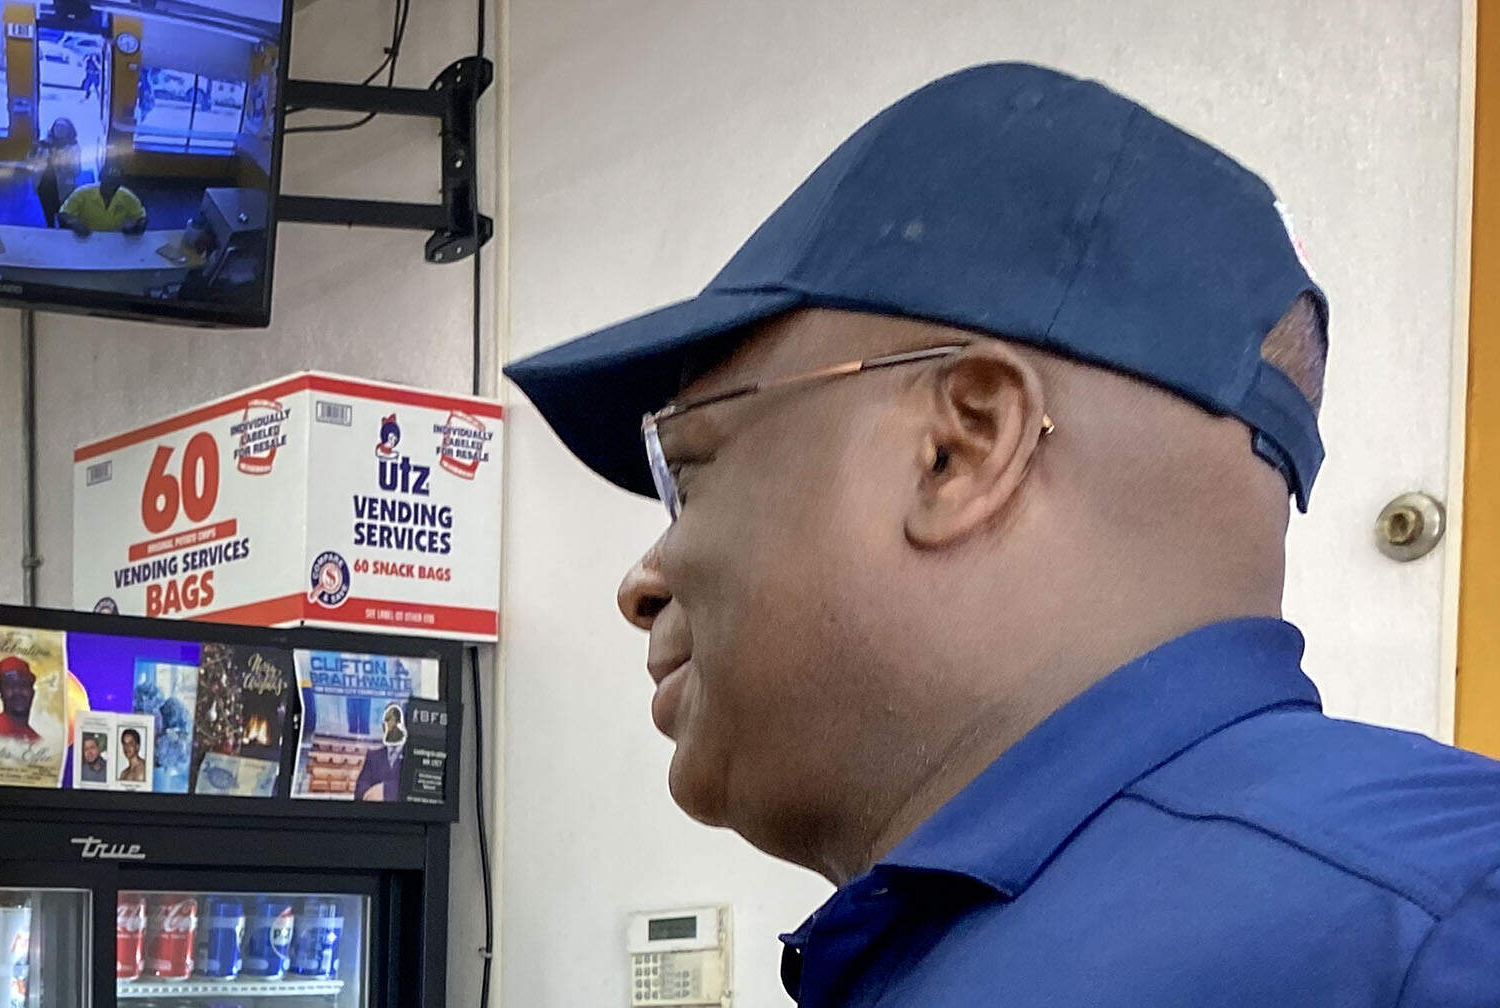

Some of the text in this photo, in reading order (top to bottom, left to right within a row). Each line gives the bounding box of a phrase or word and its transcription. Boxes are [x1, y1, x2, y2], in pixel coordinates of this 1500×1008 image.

[230, 408, 291, 436] INDIVIDUALLY
[433, 424, 493, 441] INDIVIDUALLY
[233, 434, 287, 460] FOR RESALE
[239, 425, 280, 447] LABELED
[443, 437, 484, 451] LABELED
[436, 446, 489, 462] FOR RESALE
[141, 431, 220, 534] 60
[353, 495, 453, 529] VENDING
[353, 523, 452, 555] SERVICES
[114, 537, 249, 589] VENDING SERVICES
[312, 553, 344, 581] COMPARE
[353, 559, 452, 582] 60 SNACK BAGS
[146, 570, 215, 617] BAGS
[311, 657, 387, 674] CLIFTON
[310, 672, 413, 689] BRAITHWAITE
[71, 836, 146, 859] True
